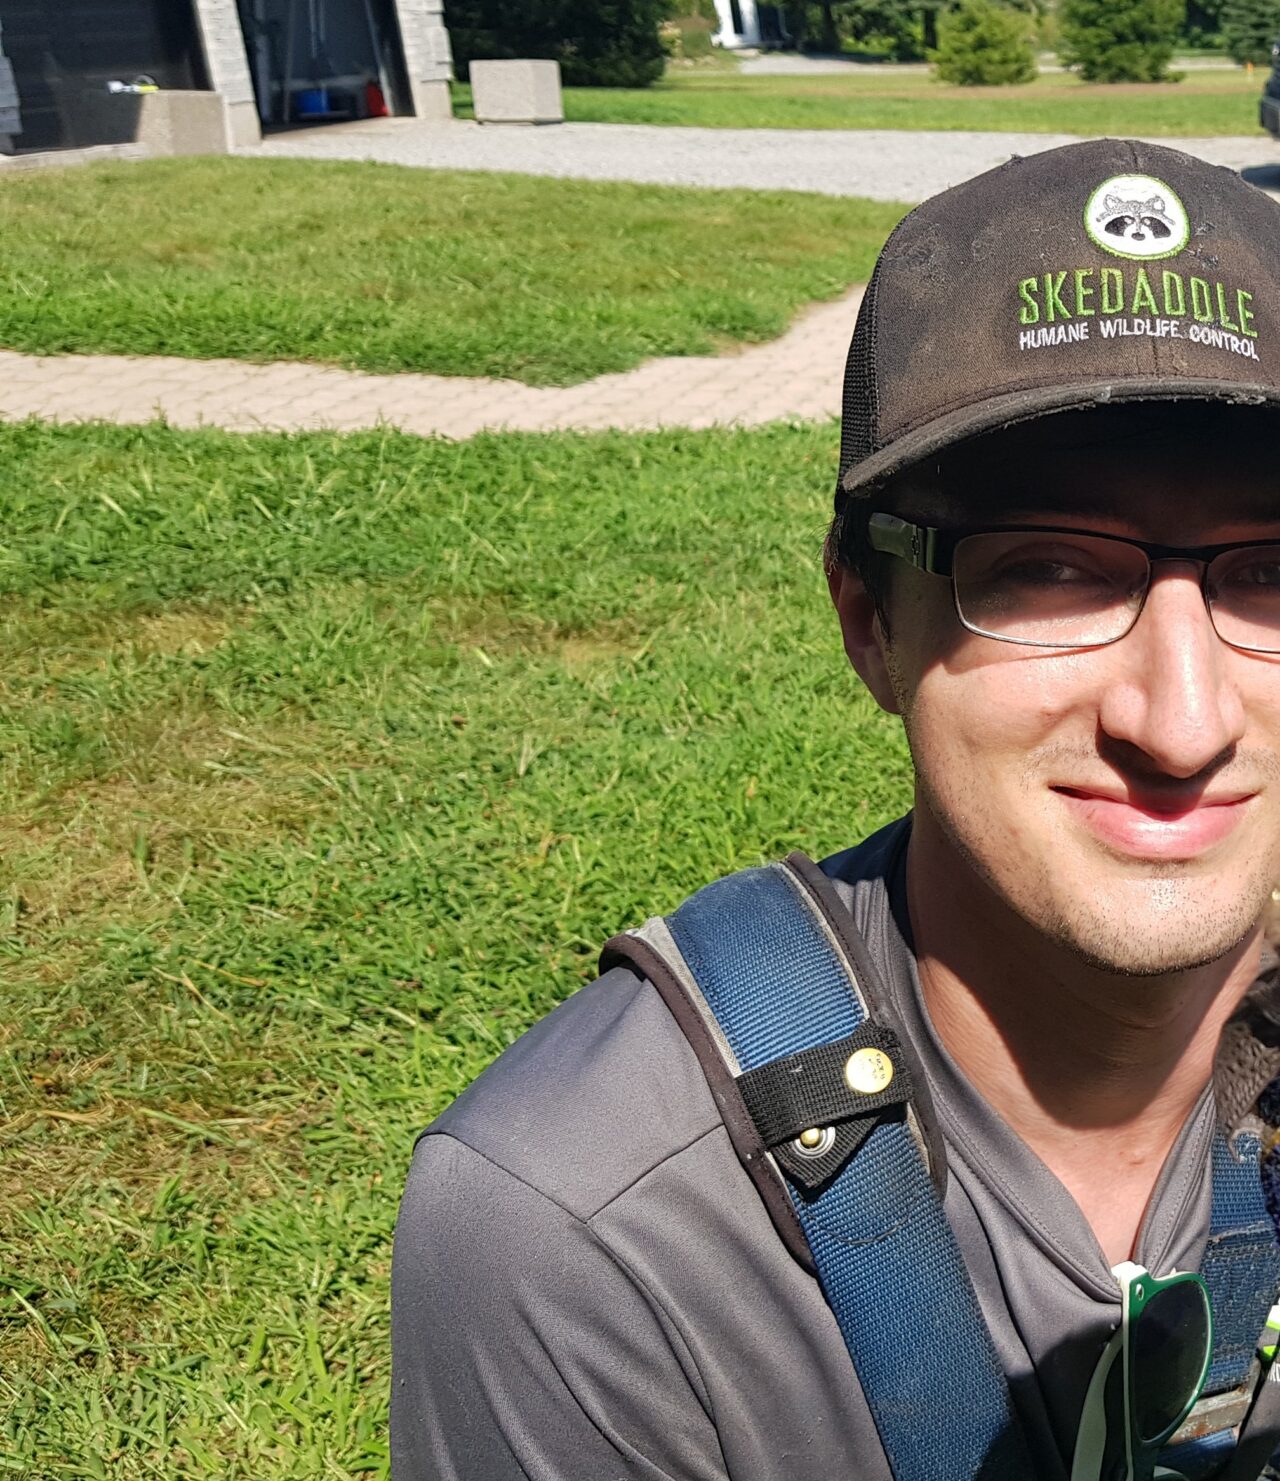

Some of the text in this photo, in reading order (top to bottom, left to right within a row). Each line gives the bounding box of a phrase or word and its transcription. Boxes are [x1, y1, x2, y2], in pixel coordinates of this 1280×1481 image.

[1018, 267, 1258, 338] SKEDADDLE
[1019, 318, 1261, 362] HUMANE WILDLIFE CONTROL
